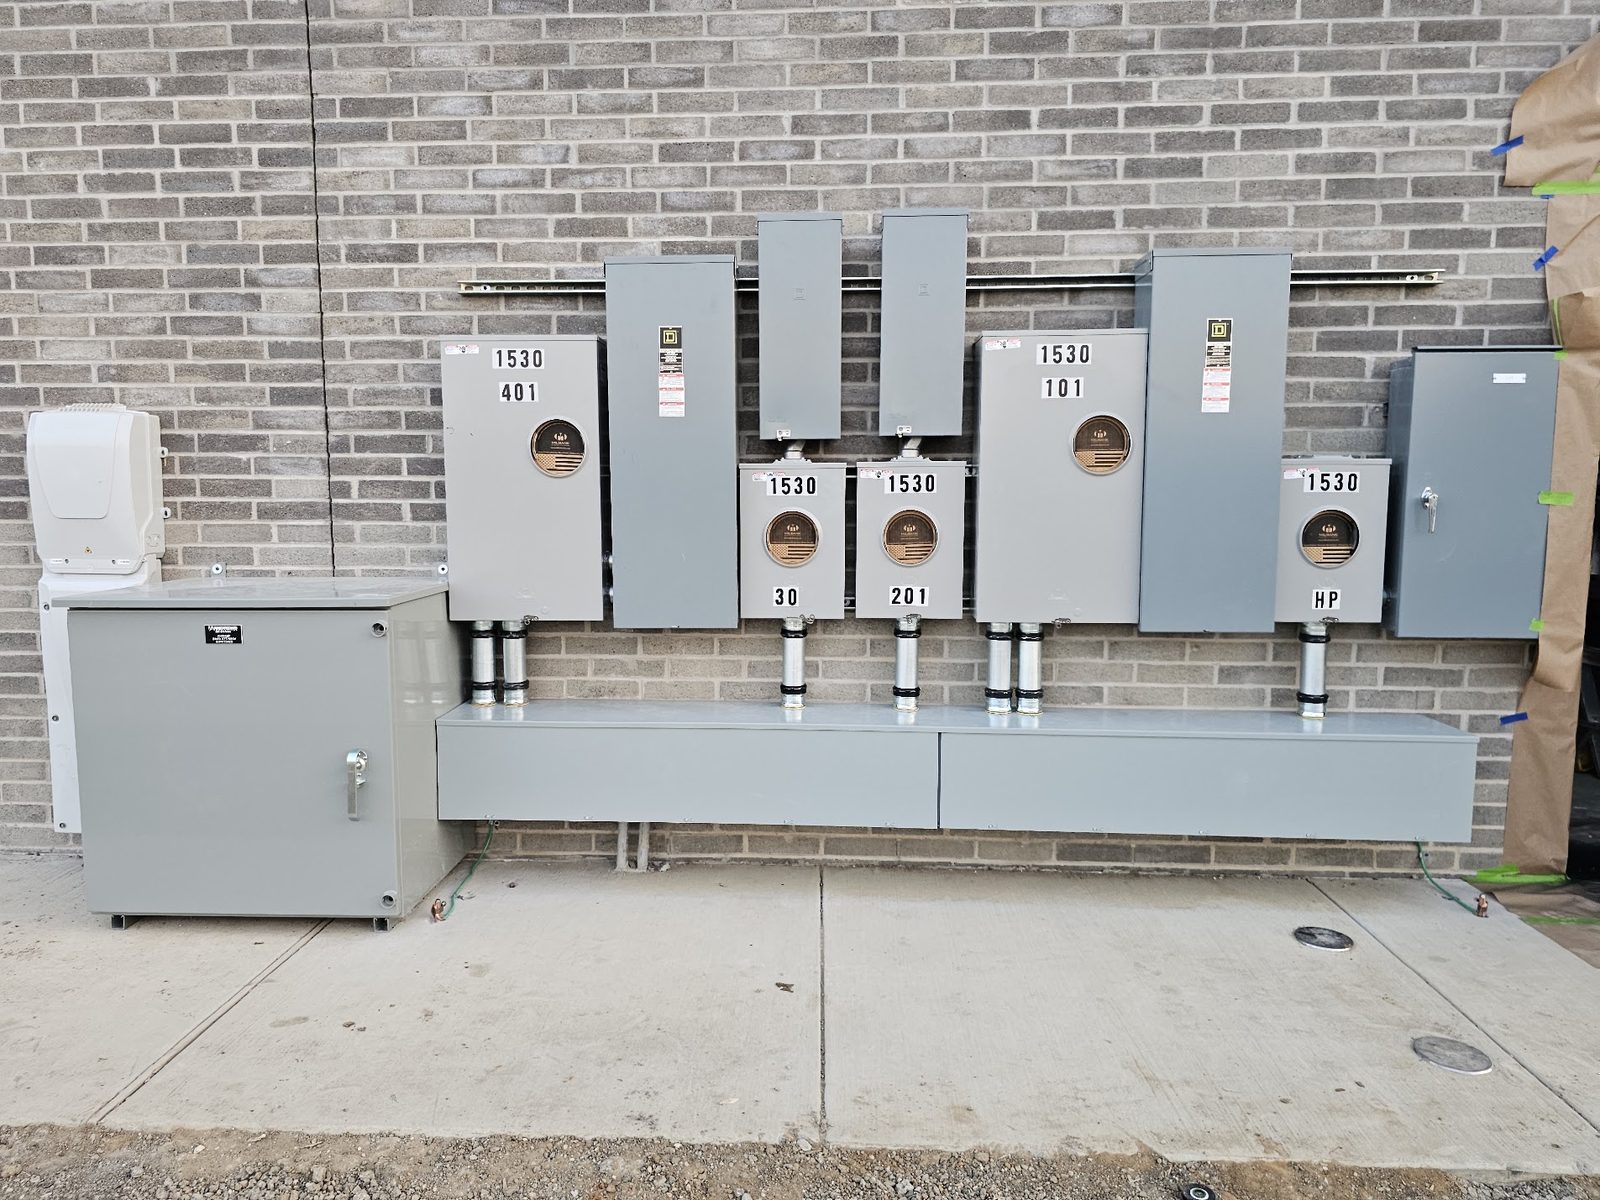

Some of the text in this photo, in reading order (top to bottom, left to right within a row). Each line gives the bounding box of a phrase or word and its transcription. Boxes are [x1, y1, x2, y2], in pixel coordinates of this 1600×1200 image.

[496, 349, 543, 368] 1530
[1041, 344, 1090, 364] 1530
[501, 382, 536, 401] 401
[1046, 378, 1081, 398] 101
[770, 476, 816, 496] 1530
[888, 474, 935, 493] 1530
[1308, 472, 1358, 492] 1530
[774, 587, 797, 606] 30
[891, 587, 926, 605] 201
[1314, 591, 1338, 609] HP
